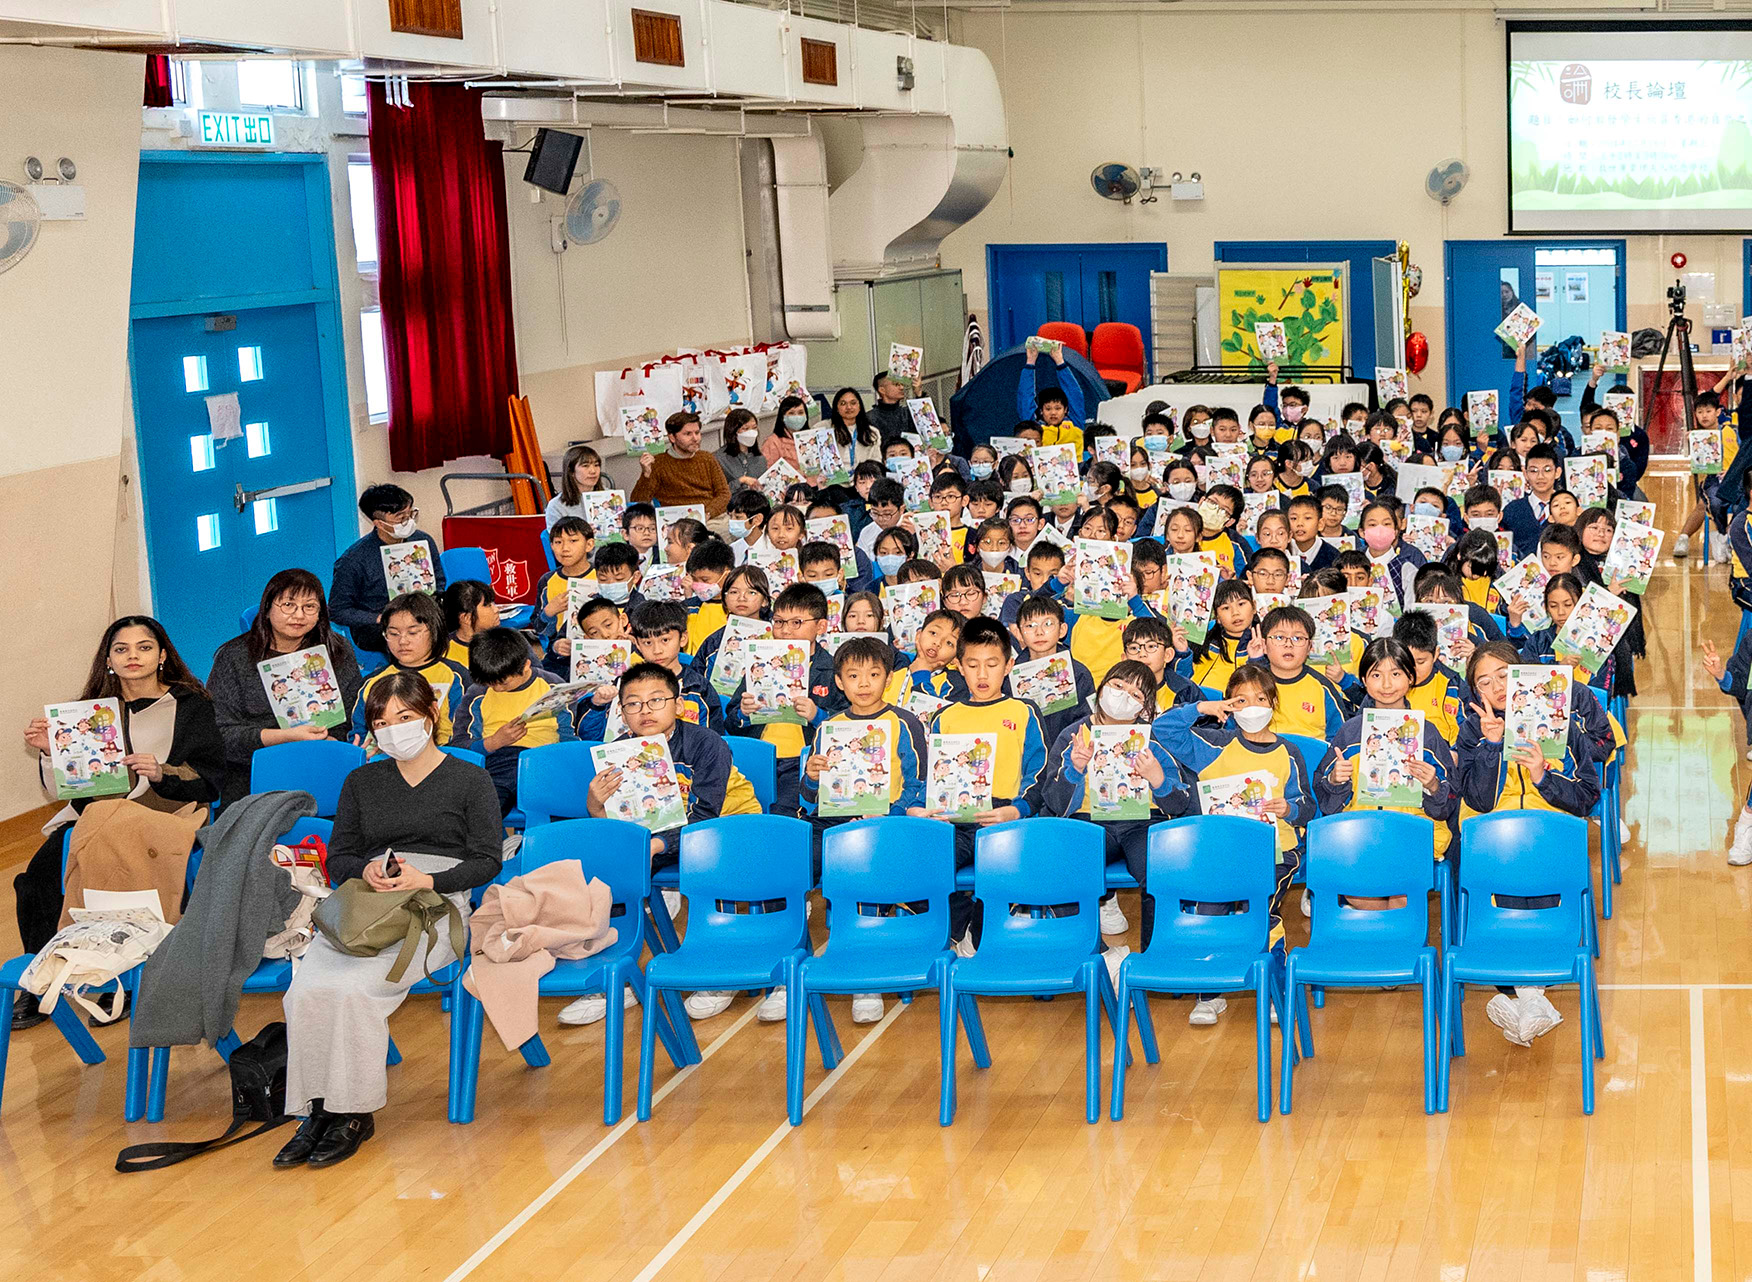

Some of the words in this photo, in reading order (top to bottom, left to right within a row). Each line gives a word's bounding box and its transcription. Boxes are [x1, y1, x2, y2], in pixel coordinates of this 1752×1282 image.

[1604, 81, 1687, 100] 校長論壇
[202, 114, 240, 142] EXIT
[244, 116, 272, 144] 出口
[504, 563, 518, 598] 救世軍
